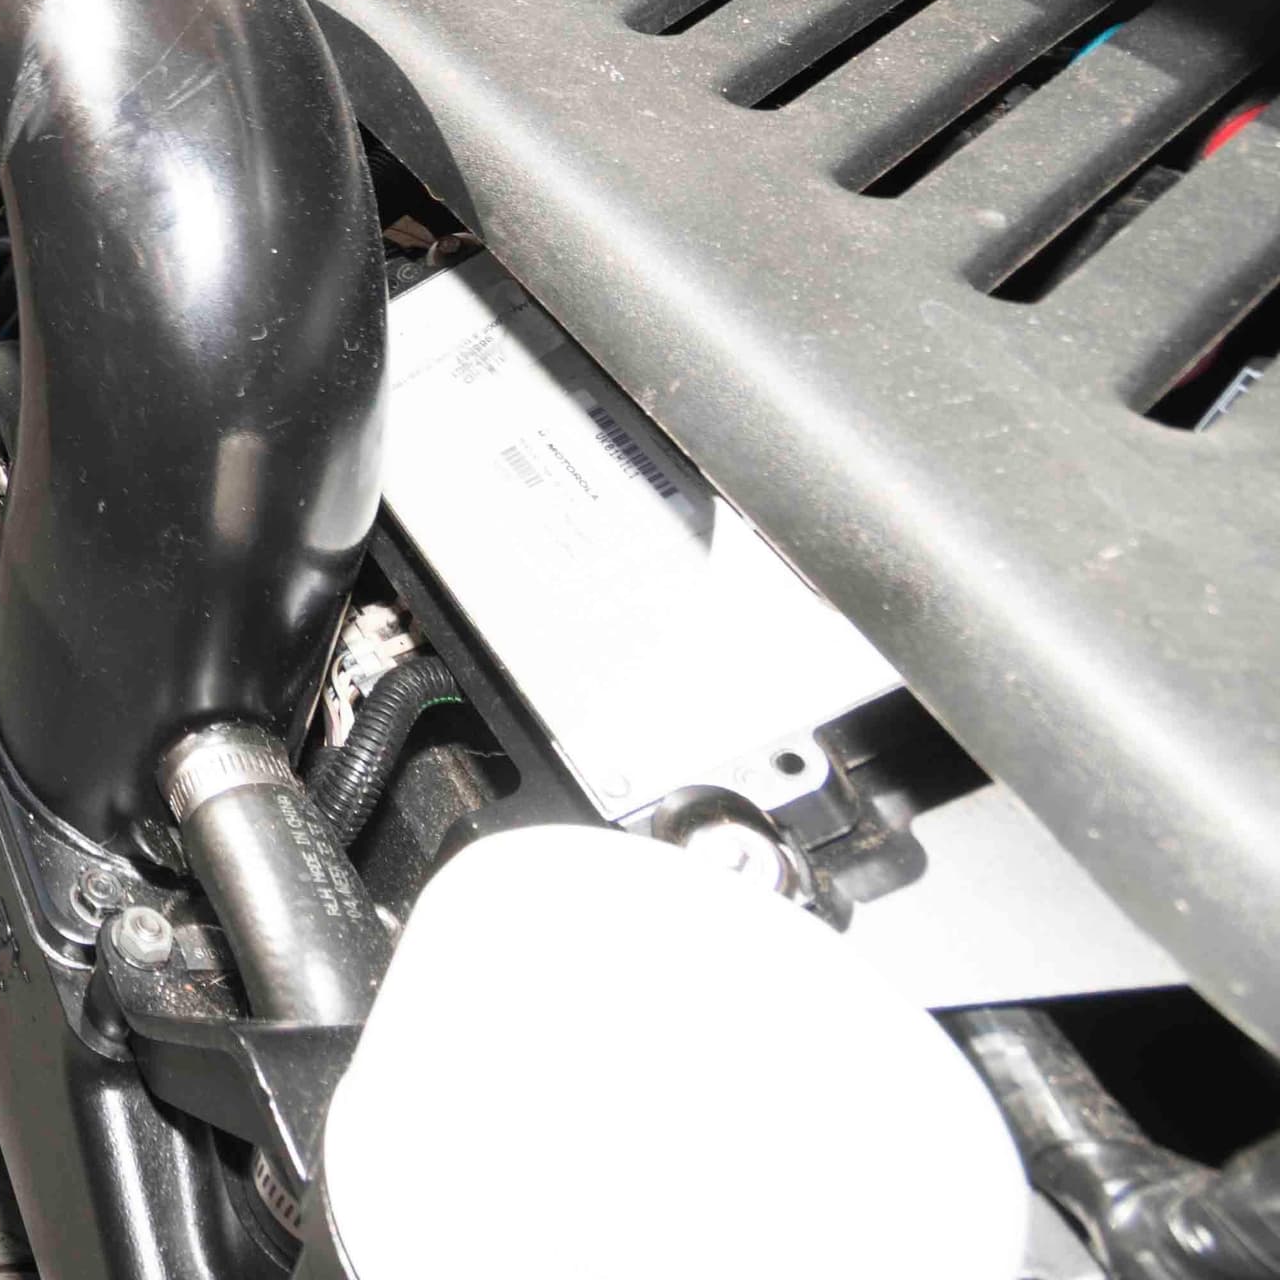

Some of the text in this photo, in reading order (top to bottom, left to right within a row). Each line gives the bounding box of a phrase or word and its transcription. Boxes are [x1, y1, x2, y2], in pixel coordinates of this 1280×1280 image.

[547, 443, 599, 500] MOTOROLA
[276, 794, 304, 826] CHINA
[301, 851, 328, 882] MADE
